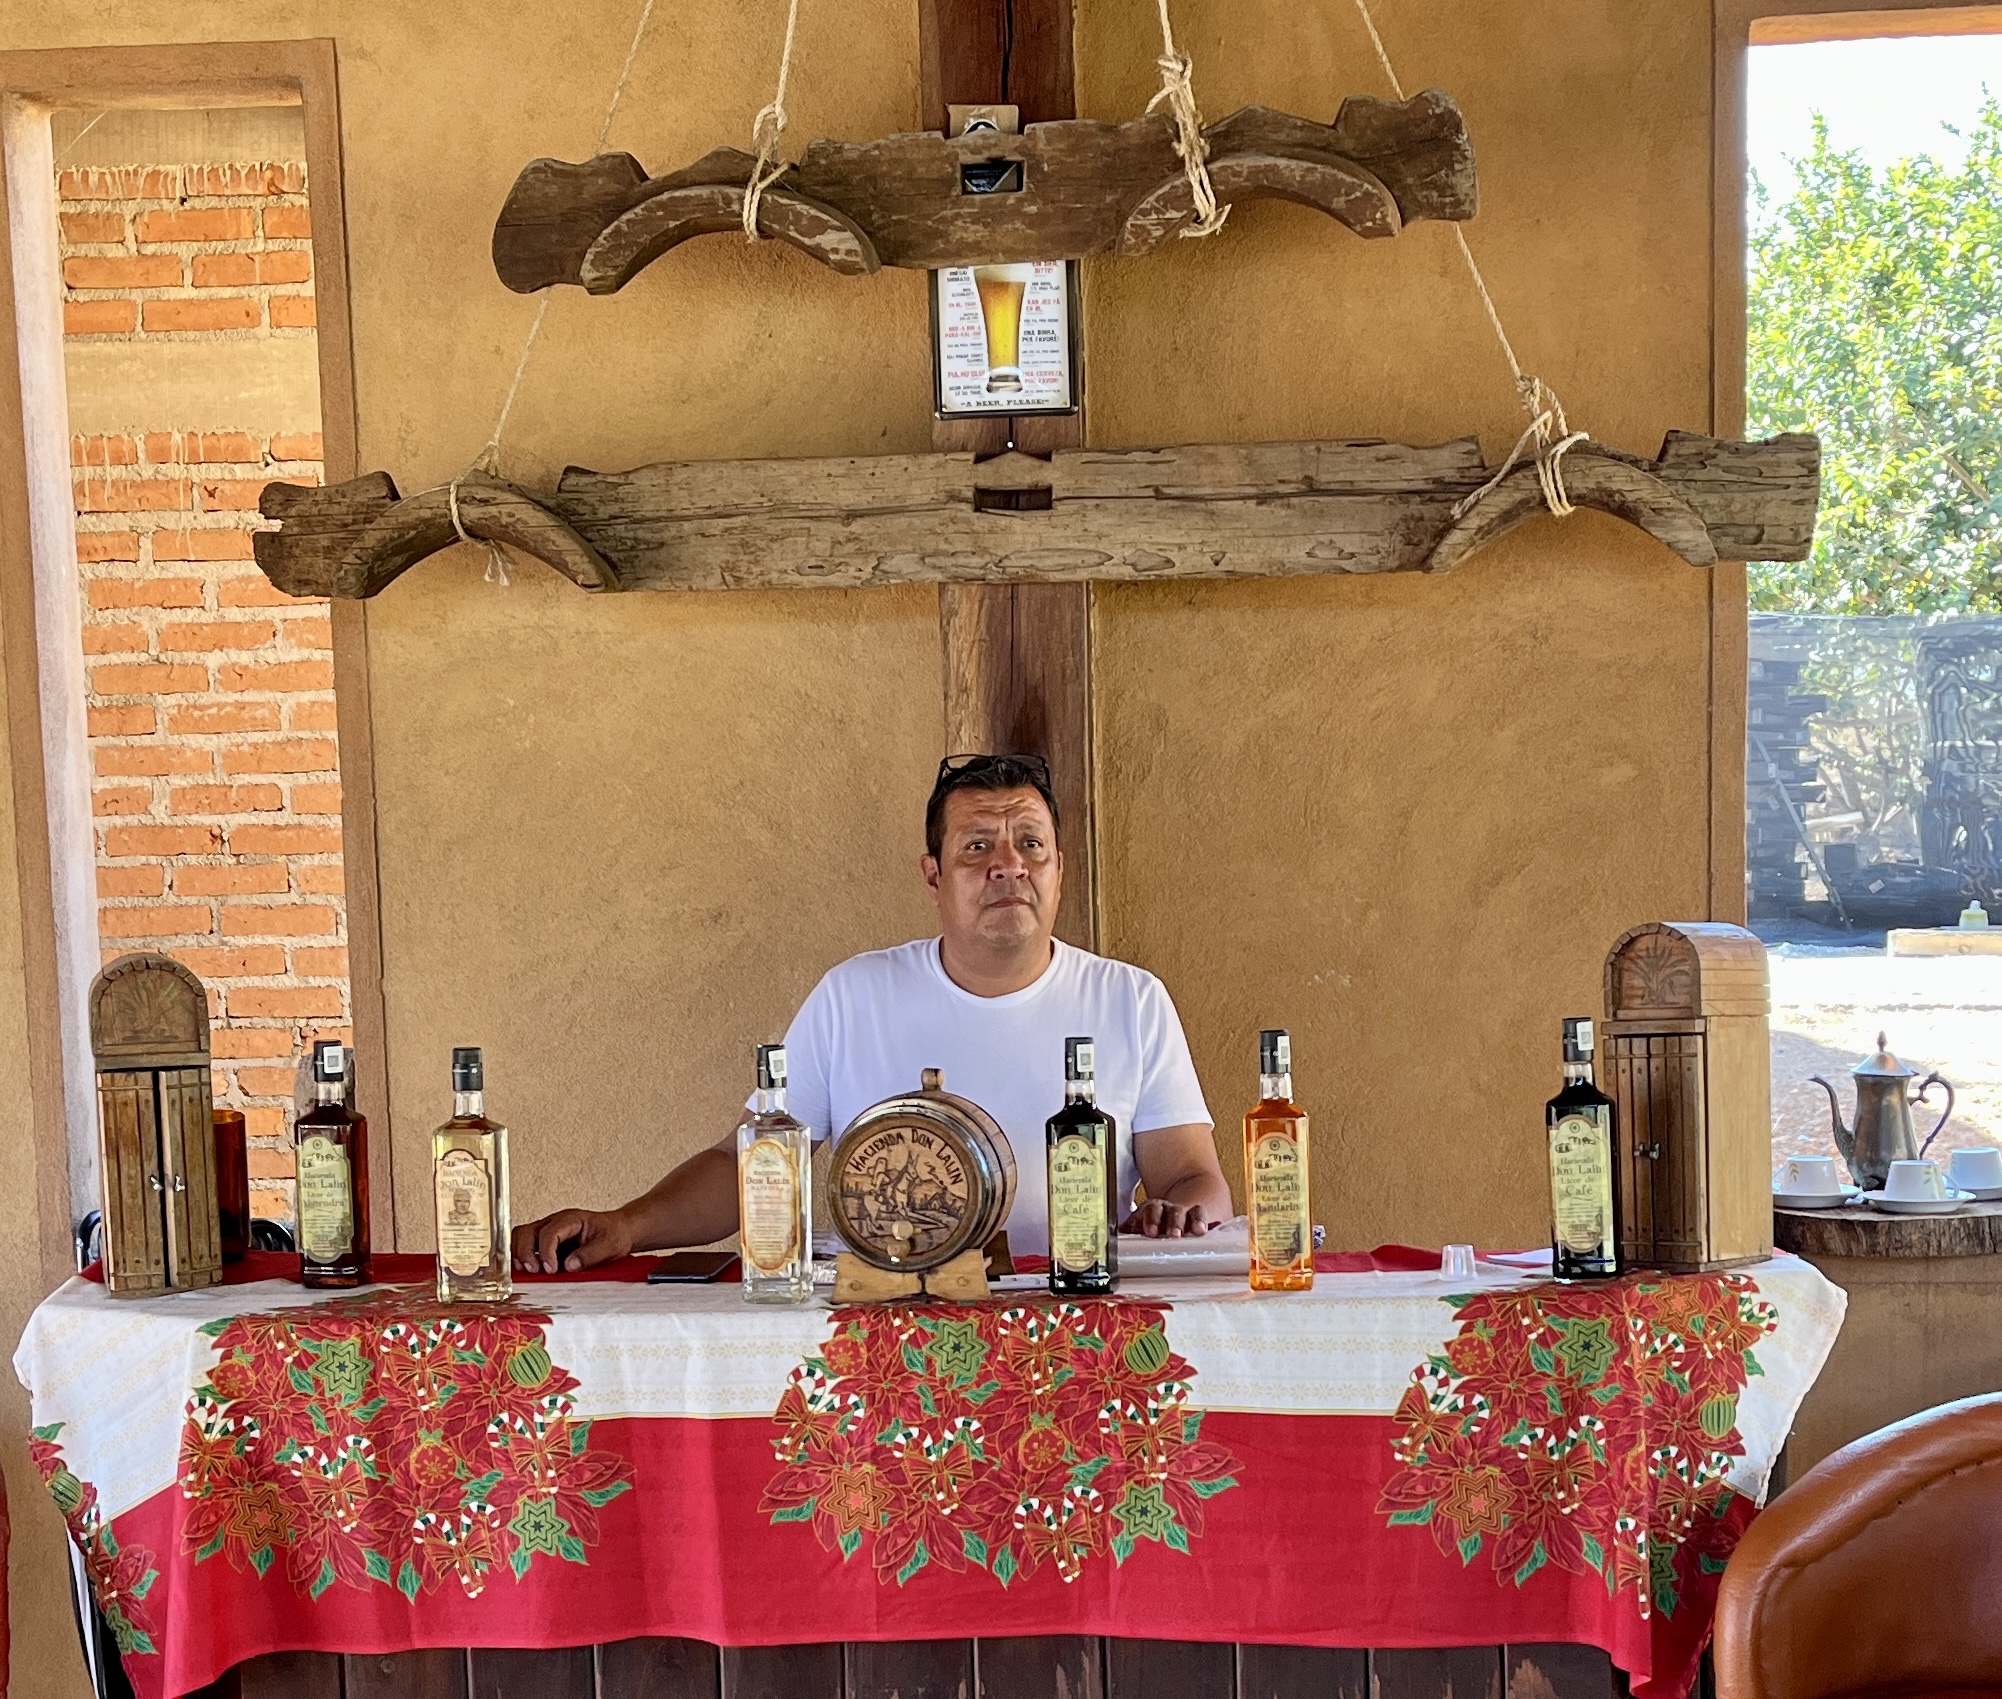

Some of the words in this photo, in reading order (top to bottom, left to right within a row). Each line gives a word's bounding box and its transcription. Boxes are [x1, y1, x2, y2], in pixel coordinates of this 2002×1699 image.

[849, 1132, 905, 1172] HACIENDA
[911, 1128, 934, 1150] DON
[936, 1140, 964, 1186] LALIN
